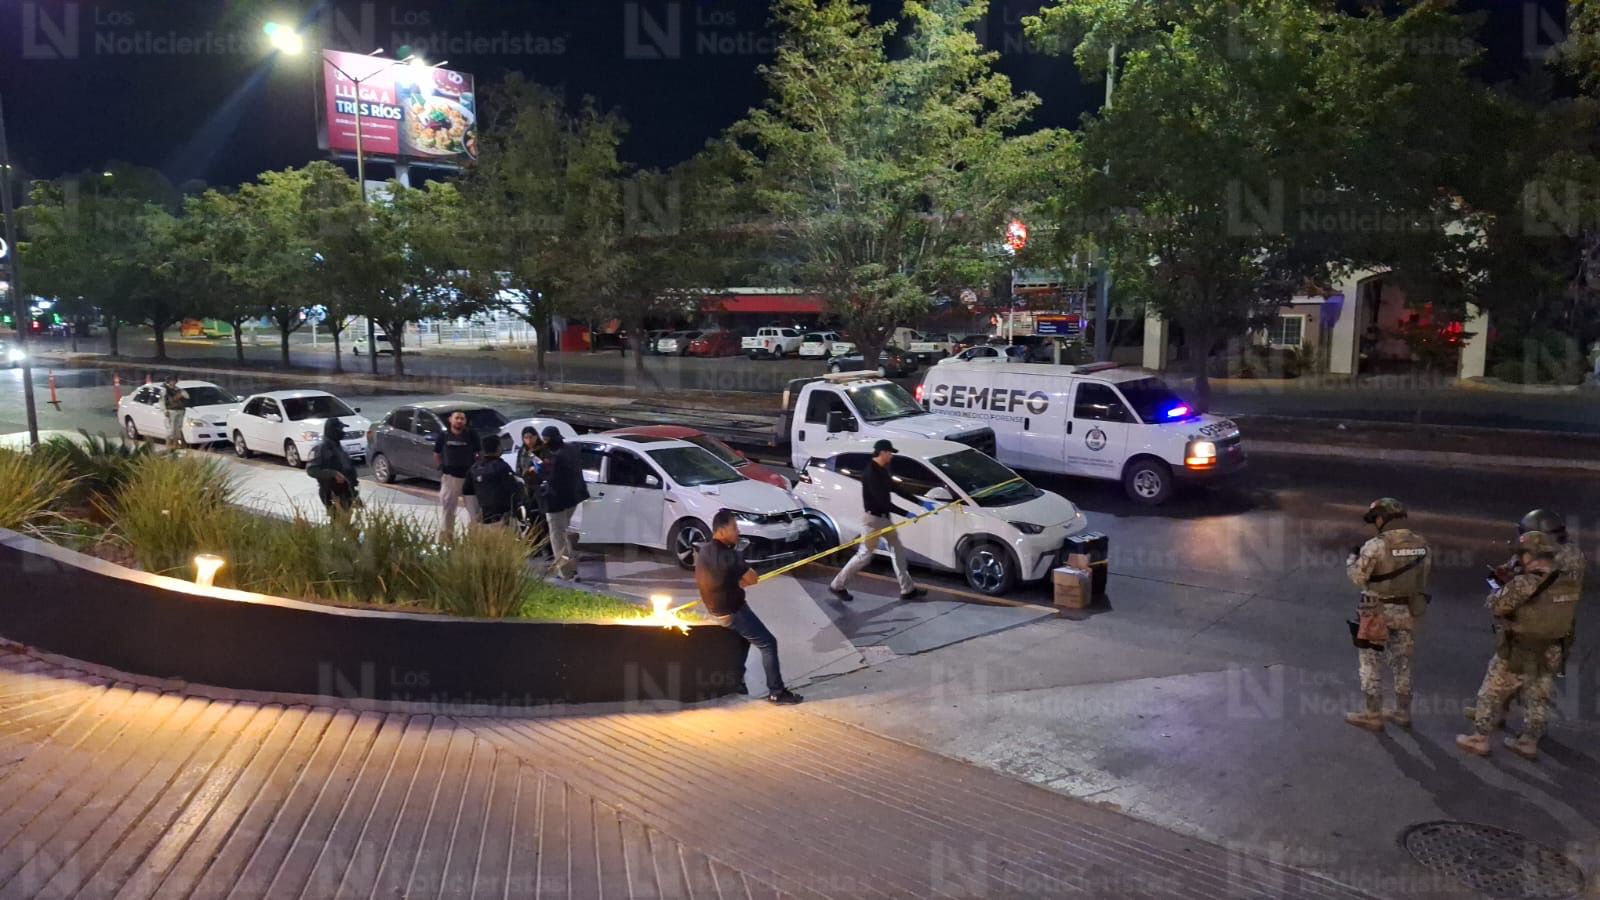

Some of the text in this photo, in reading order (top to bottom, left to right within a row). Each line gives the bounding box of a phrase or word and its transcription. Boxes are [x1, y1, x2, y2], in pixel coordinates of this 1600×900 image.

[371, 102, 402, 120] RÍOS
[932, 384, 1049, 415] SEMEFO
[990, 414, 1025, 423] FORENSE
